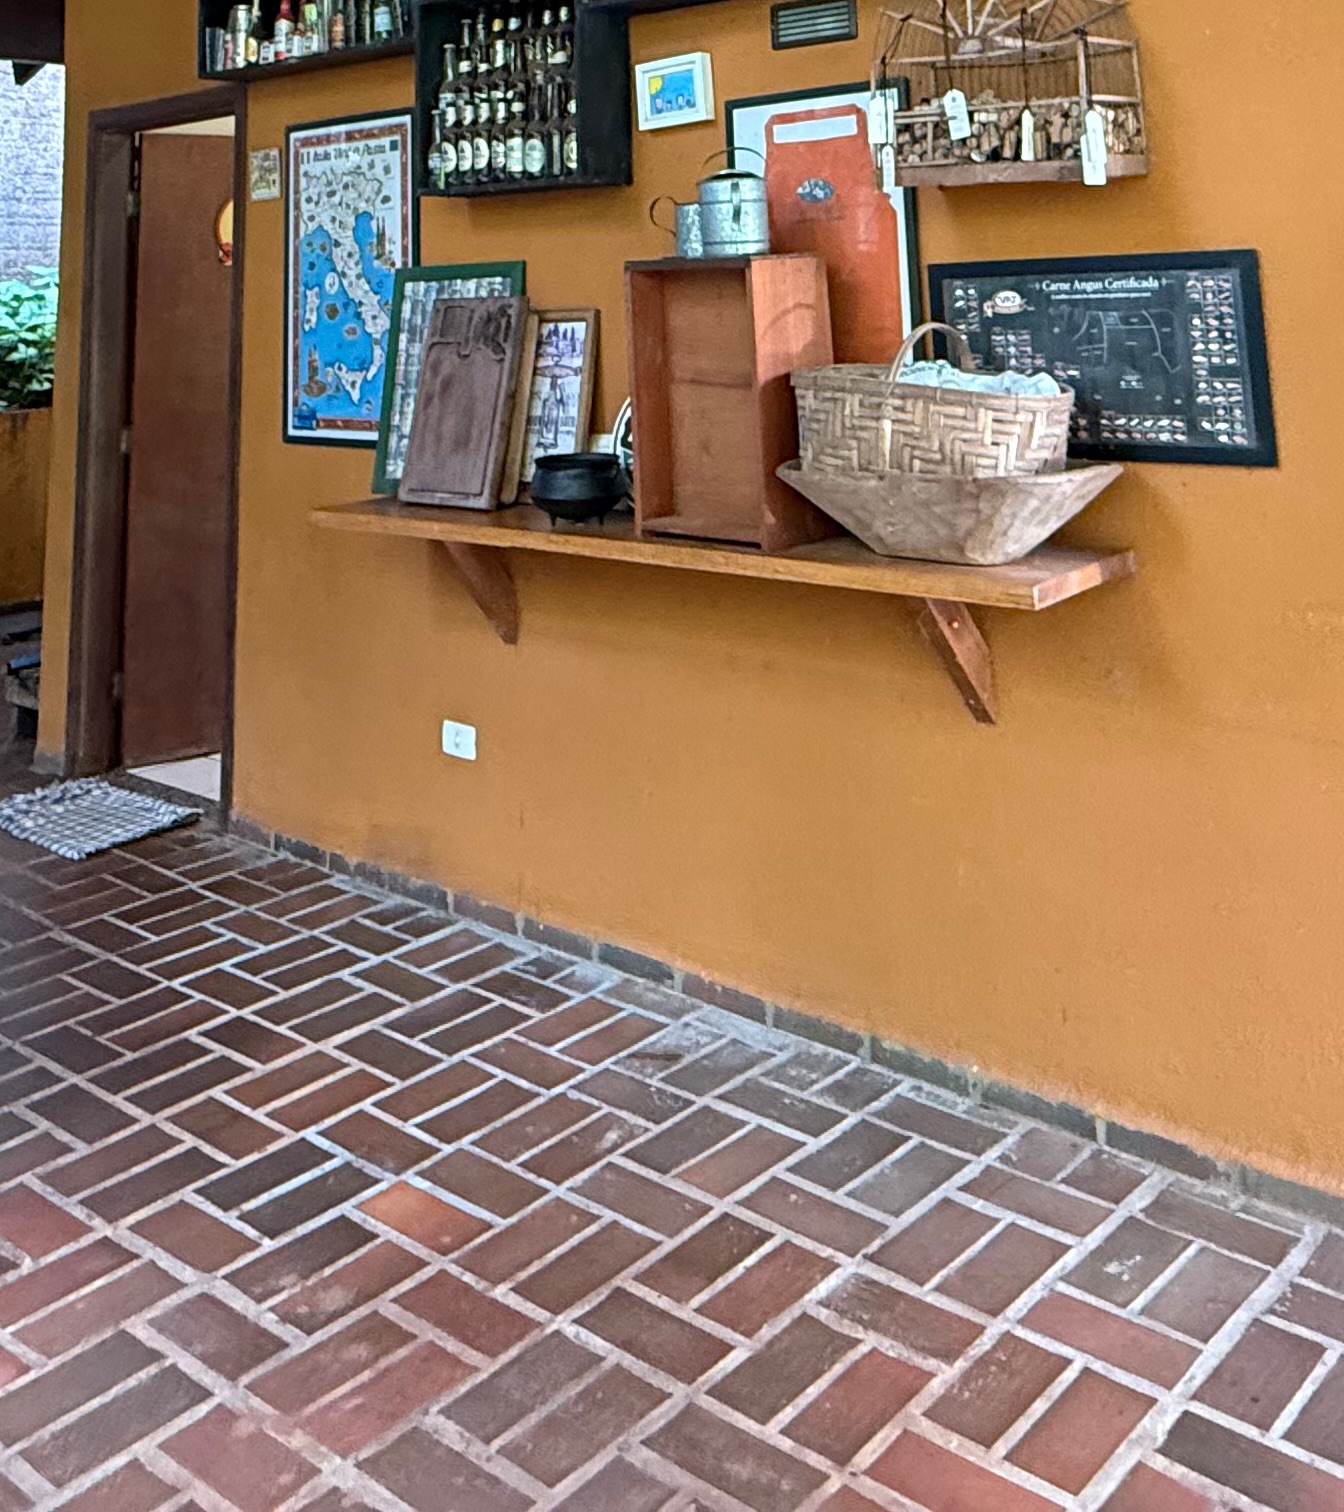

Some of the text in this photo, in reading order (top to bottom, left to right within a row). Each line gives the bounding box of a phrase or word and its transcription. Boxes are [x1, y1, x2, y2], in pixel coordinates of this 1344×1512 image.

[1042, 275, 1160, 293] Carne Angus Certificada
